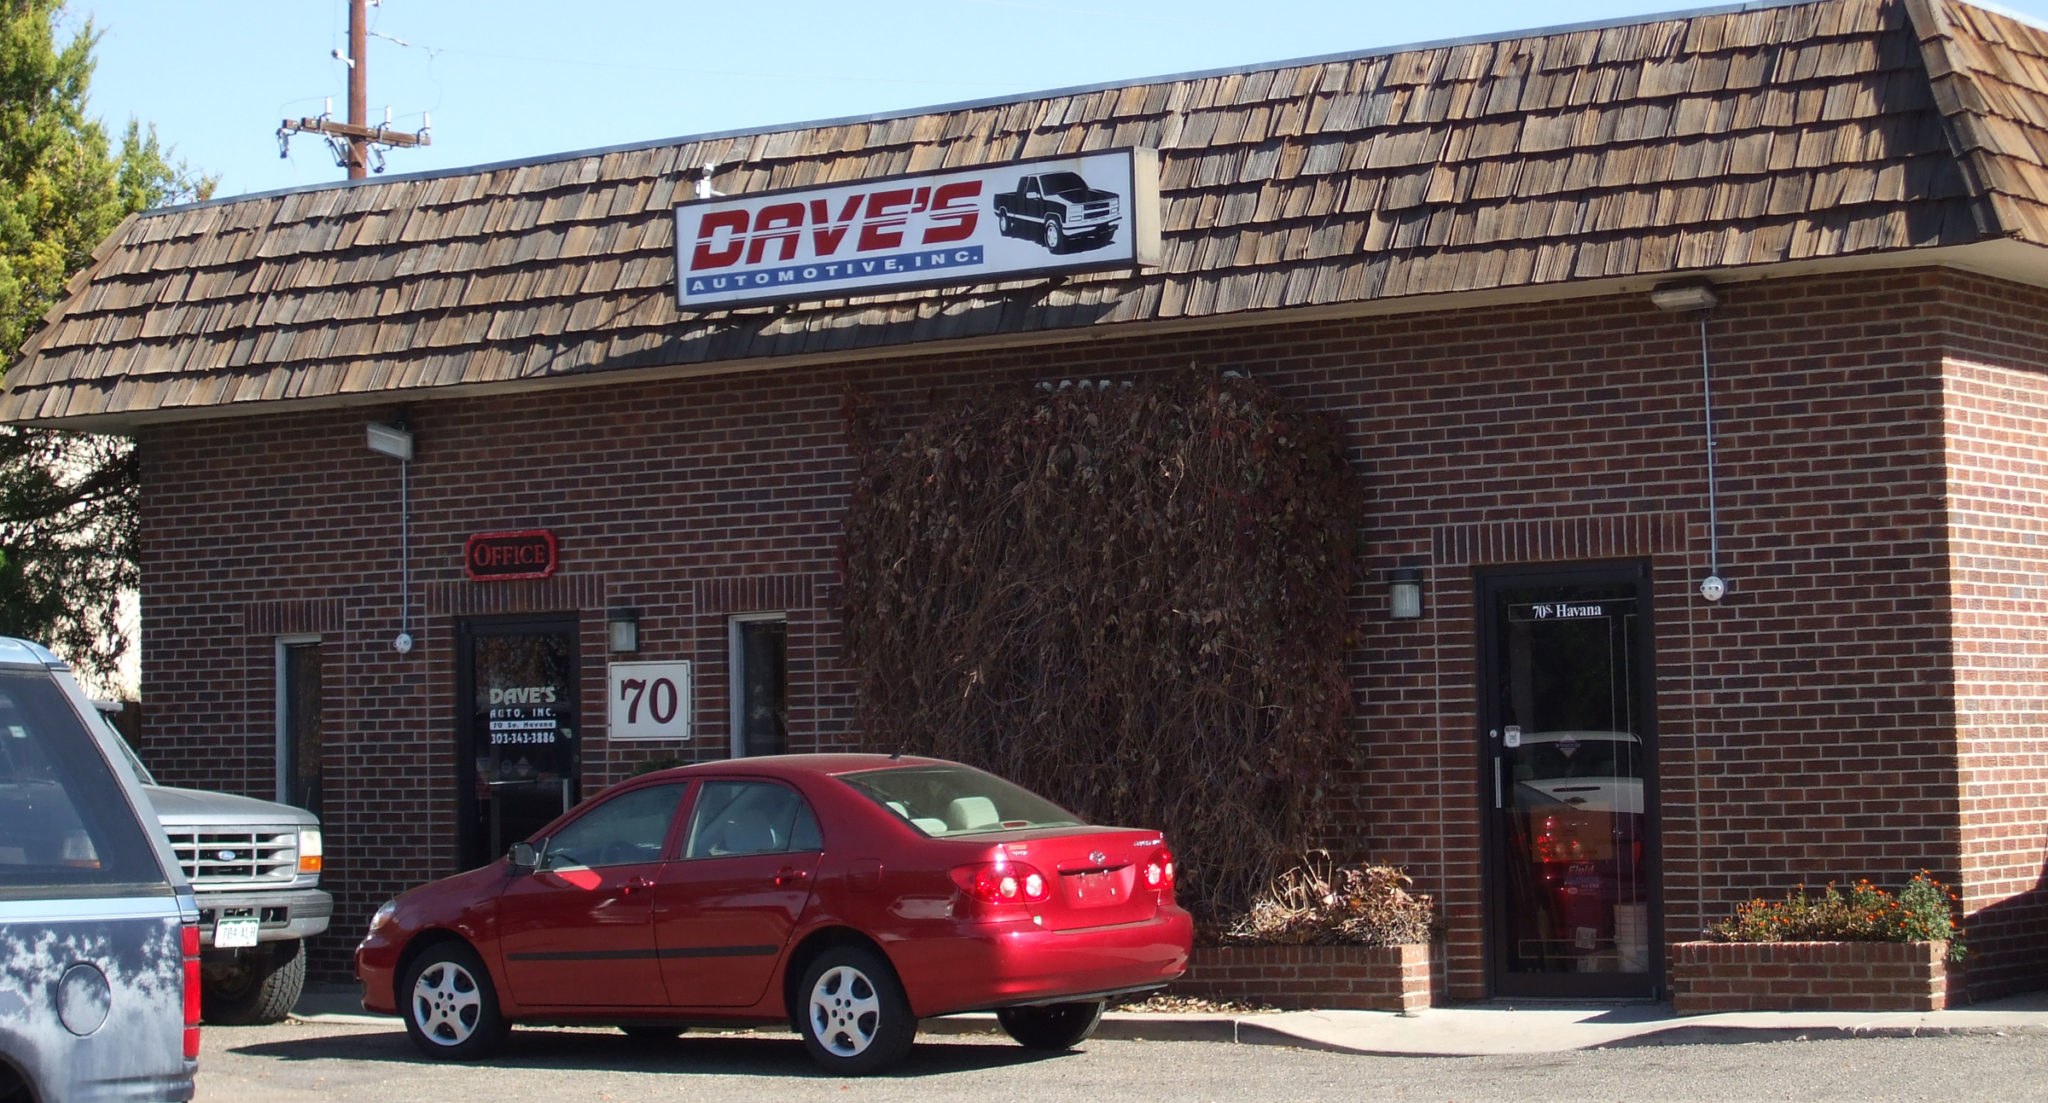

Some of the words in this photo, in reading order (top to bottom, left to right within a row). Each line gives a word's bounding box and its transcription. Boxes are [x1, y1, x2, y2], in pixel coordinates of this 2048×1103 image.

[690, 180, 983, 271] DAVE'S
[914, 250, 979, 268] INC.
[1556, 603, 1602, 617] Havana
[490, 686, 556, 705] DAVE'S
[620, 677, 678, 725] 70
[532, 707, 556, 718] INC.
[490, 732, 555, 744] 303-343-3886
